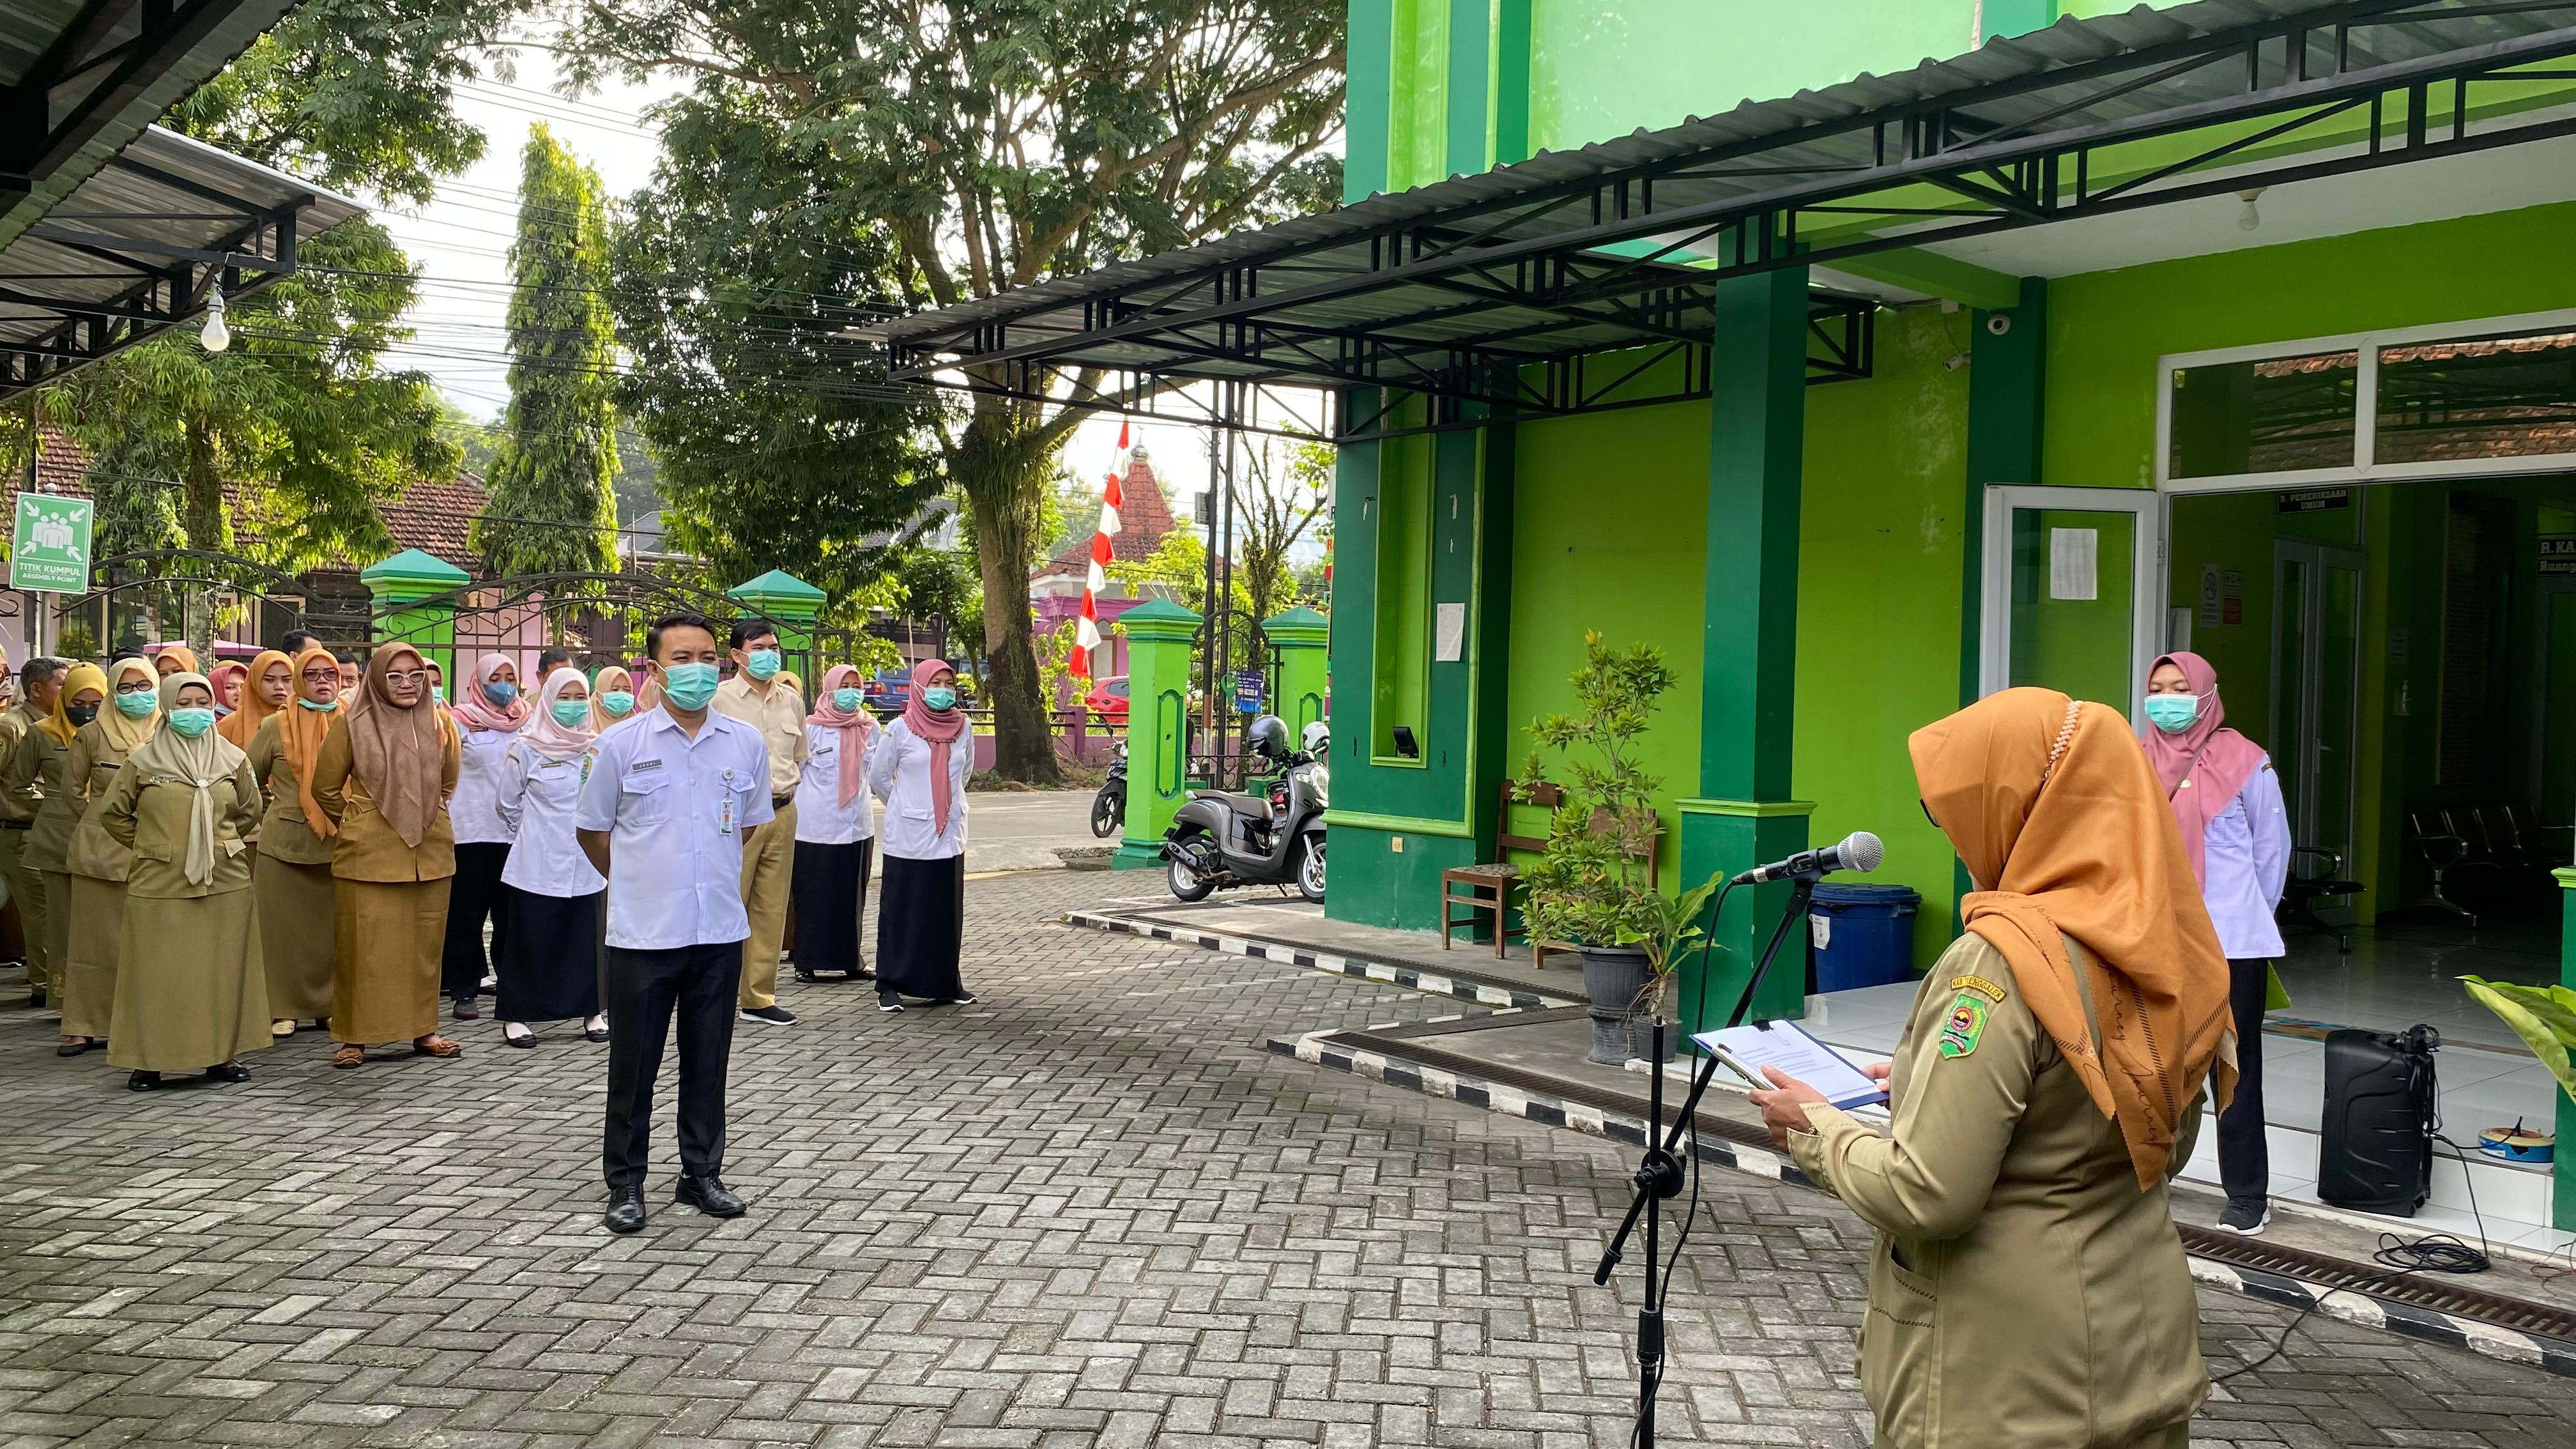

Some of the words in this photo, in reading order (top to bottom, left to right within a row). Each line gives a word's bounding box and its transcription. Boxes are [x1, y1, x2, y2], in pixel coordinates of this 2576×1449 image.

[2290, 489, 2347, 502] PEMERIKSAAN
[2301, 500, 2326, 510] UMUM
[2540, 542, 2554, 553] R.
[2556, 541, 2576, 553] KA
[18, 562, 42, 572] TITIK
[43, 565, 81, 576] KUMPUL
[22, 572, 56, 581] ASSEMBLY
